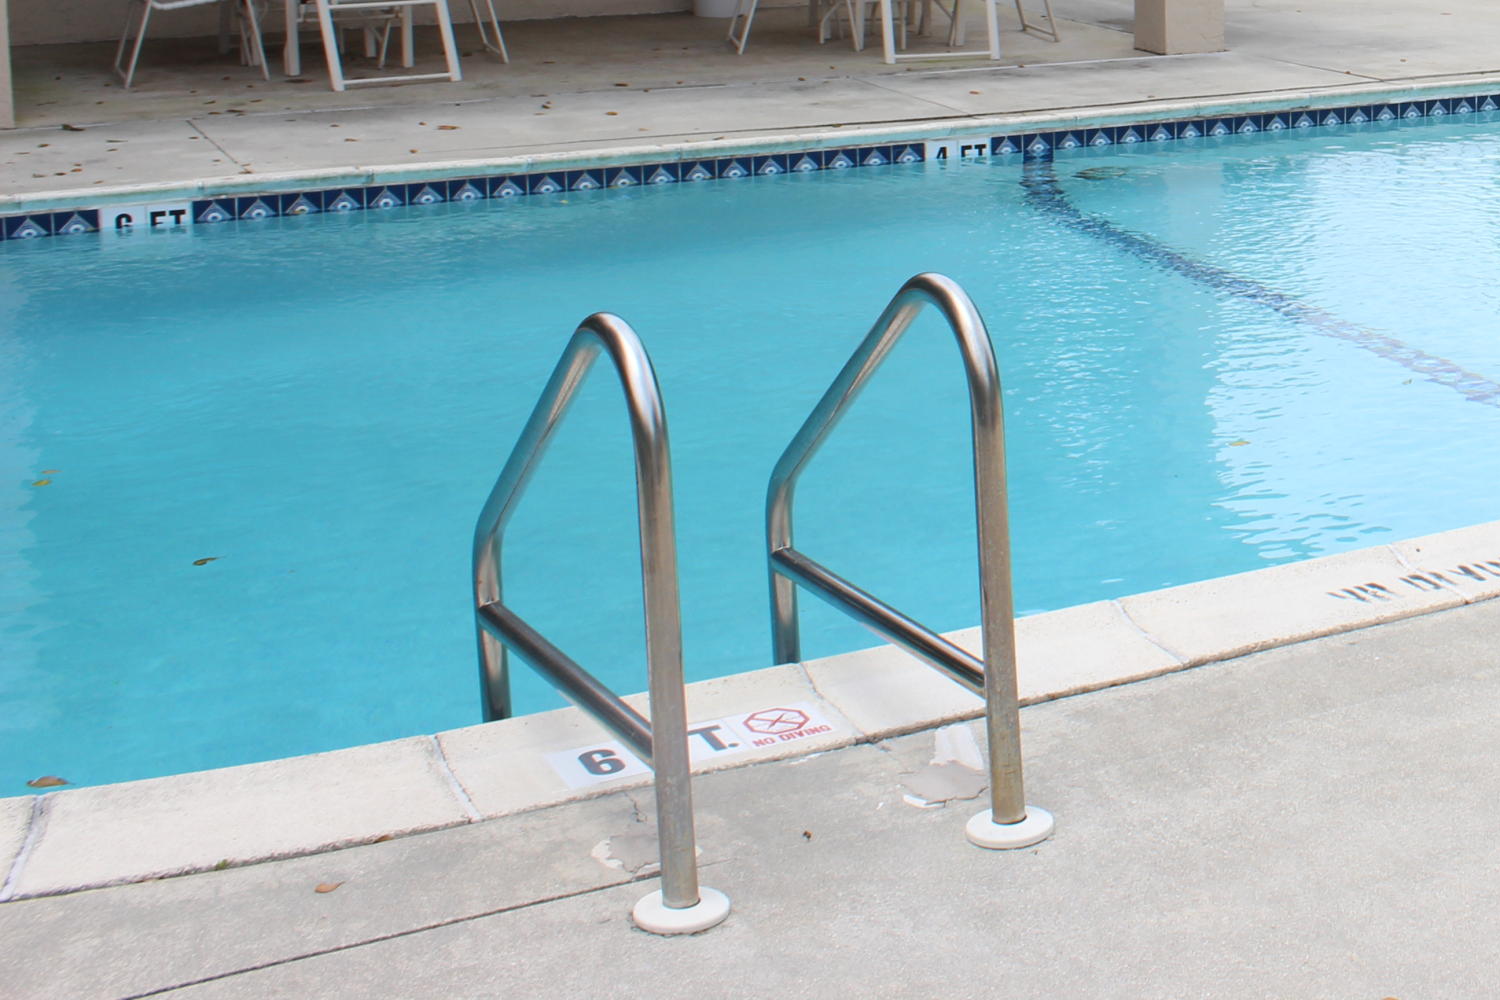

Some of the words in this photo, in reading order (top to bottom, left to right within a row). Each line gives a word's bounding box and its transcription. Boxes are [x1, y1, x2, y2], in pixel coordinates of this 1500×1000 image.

[577, 748, 627, 776] 6
[687, 724, 740, 752] T.
[752, 736, 776, 747] NO
[779, 724, 833, 742] DIVING
